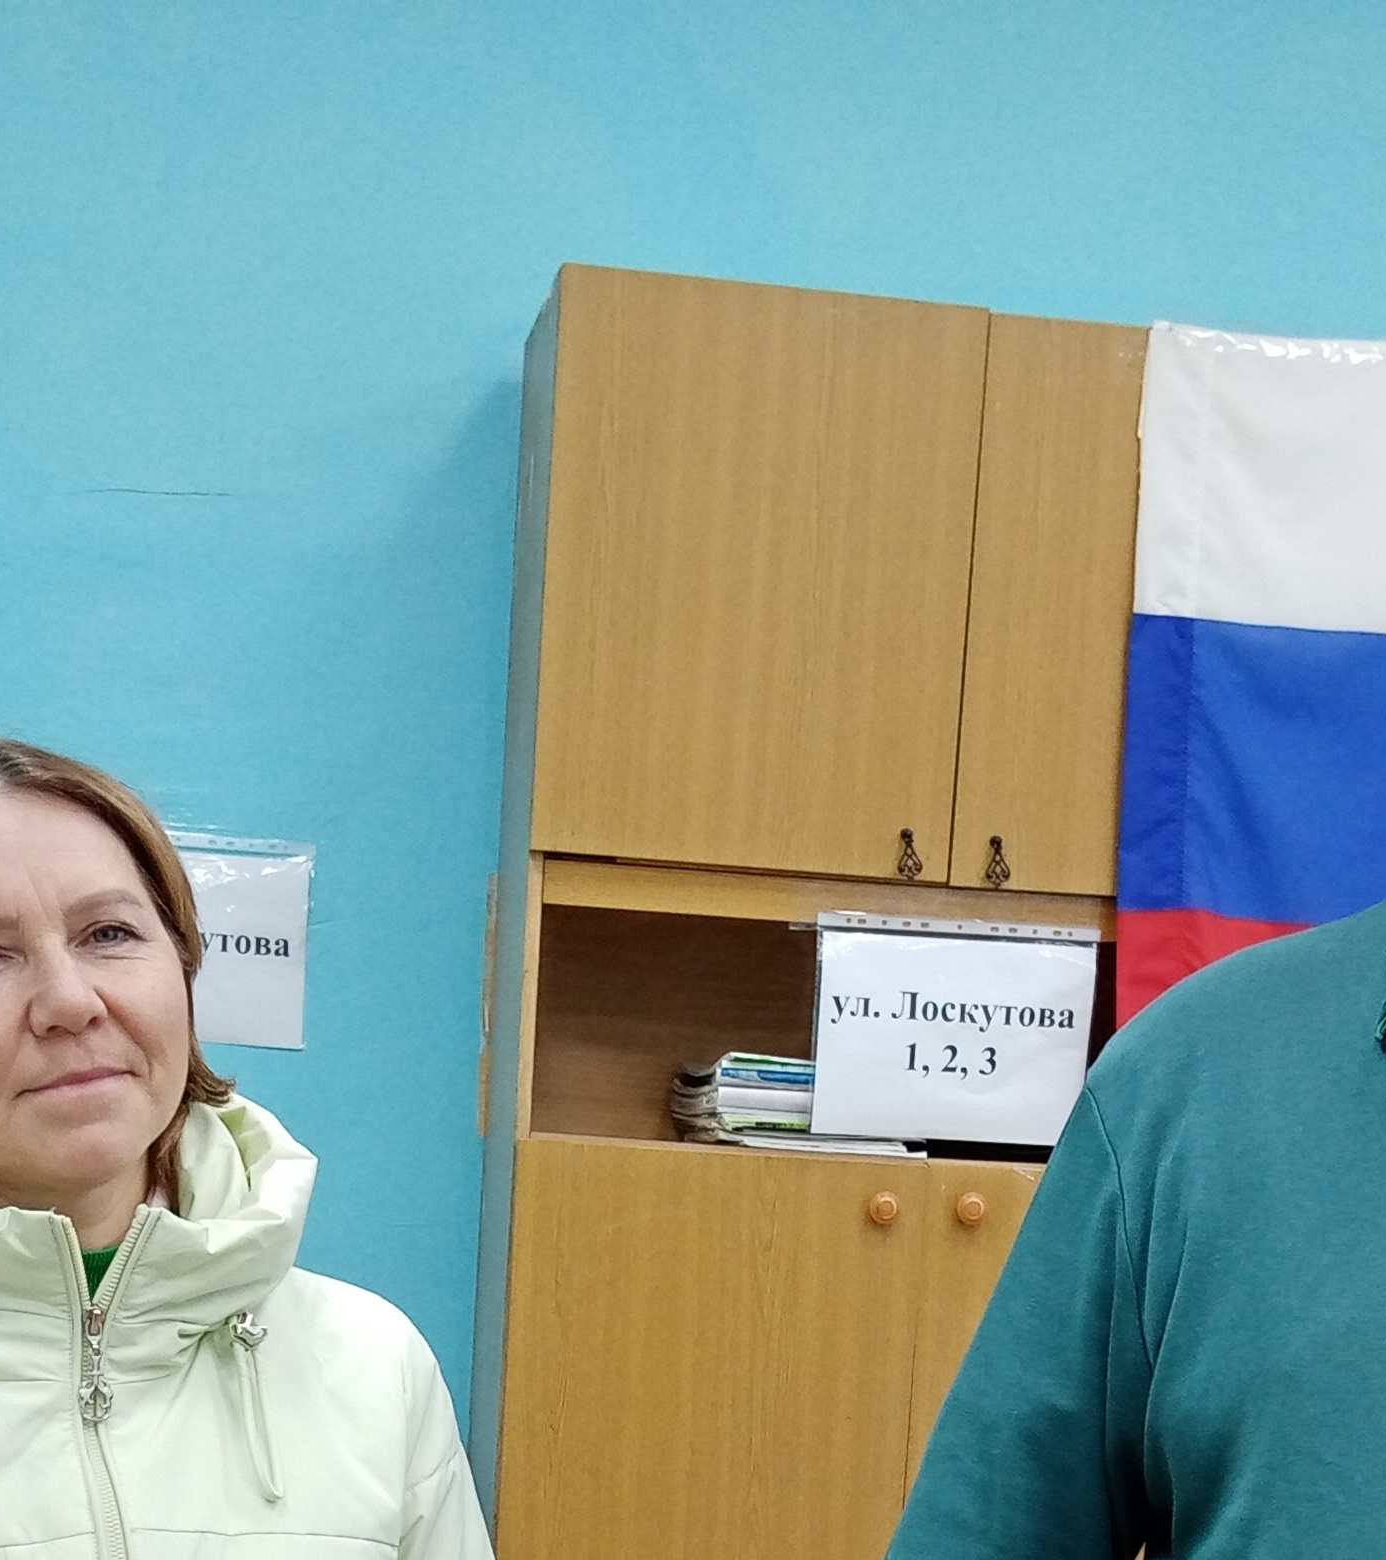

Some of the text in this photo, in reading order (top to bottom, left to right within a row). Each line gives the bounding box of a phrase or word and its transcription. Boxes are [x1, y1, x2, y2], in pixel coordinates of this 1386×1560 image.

[200, 931, 291, 959] утова
[830, 990, 1076, 1033] ул. Лоскутова
[905, 1042, 998, 1080] 1, 2, 3
